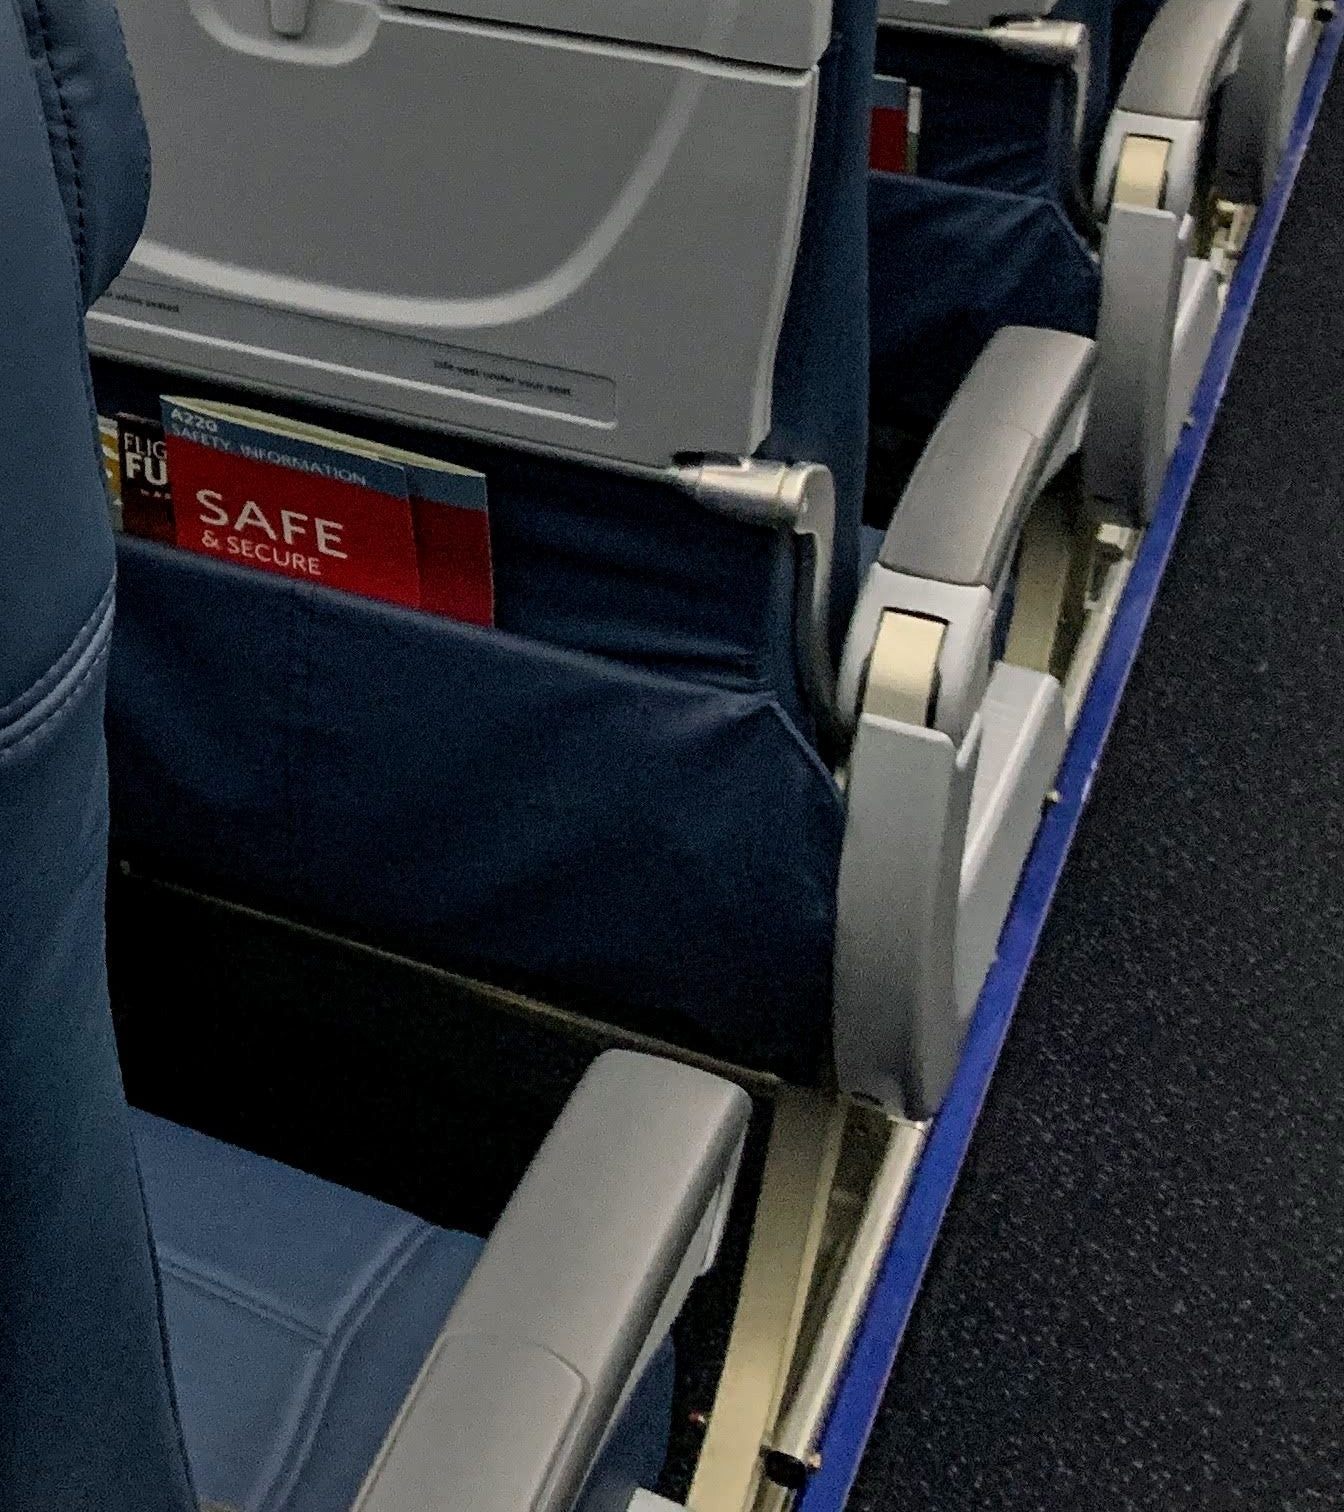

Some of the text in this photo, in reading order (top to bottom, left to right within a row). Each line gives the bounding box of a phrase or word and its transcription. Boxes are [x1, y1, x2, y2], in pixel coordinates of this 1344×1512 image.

[172, 408, 218, 432] A220
[124, 432, 167, 460] FLIG
[172, 422, 367, 486] SAFETY INFORMATION
[196, 489, 348, 559] SAFE
[202, 530, 322, 576] & SECURE
